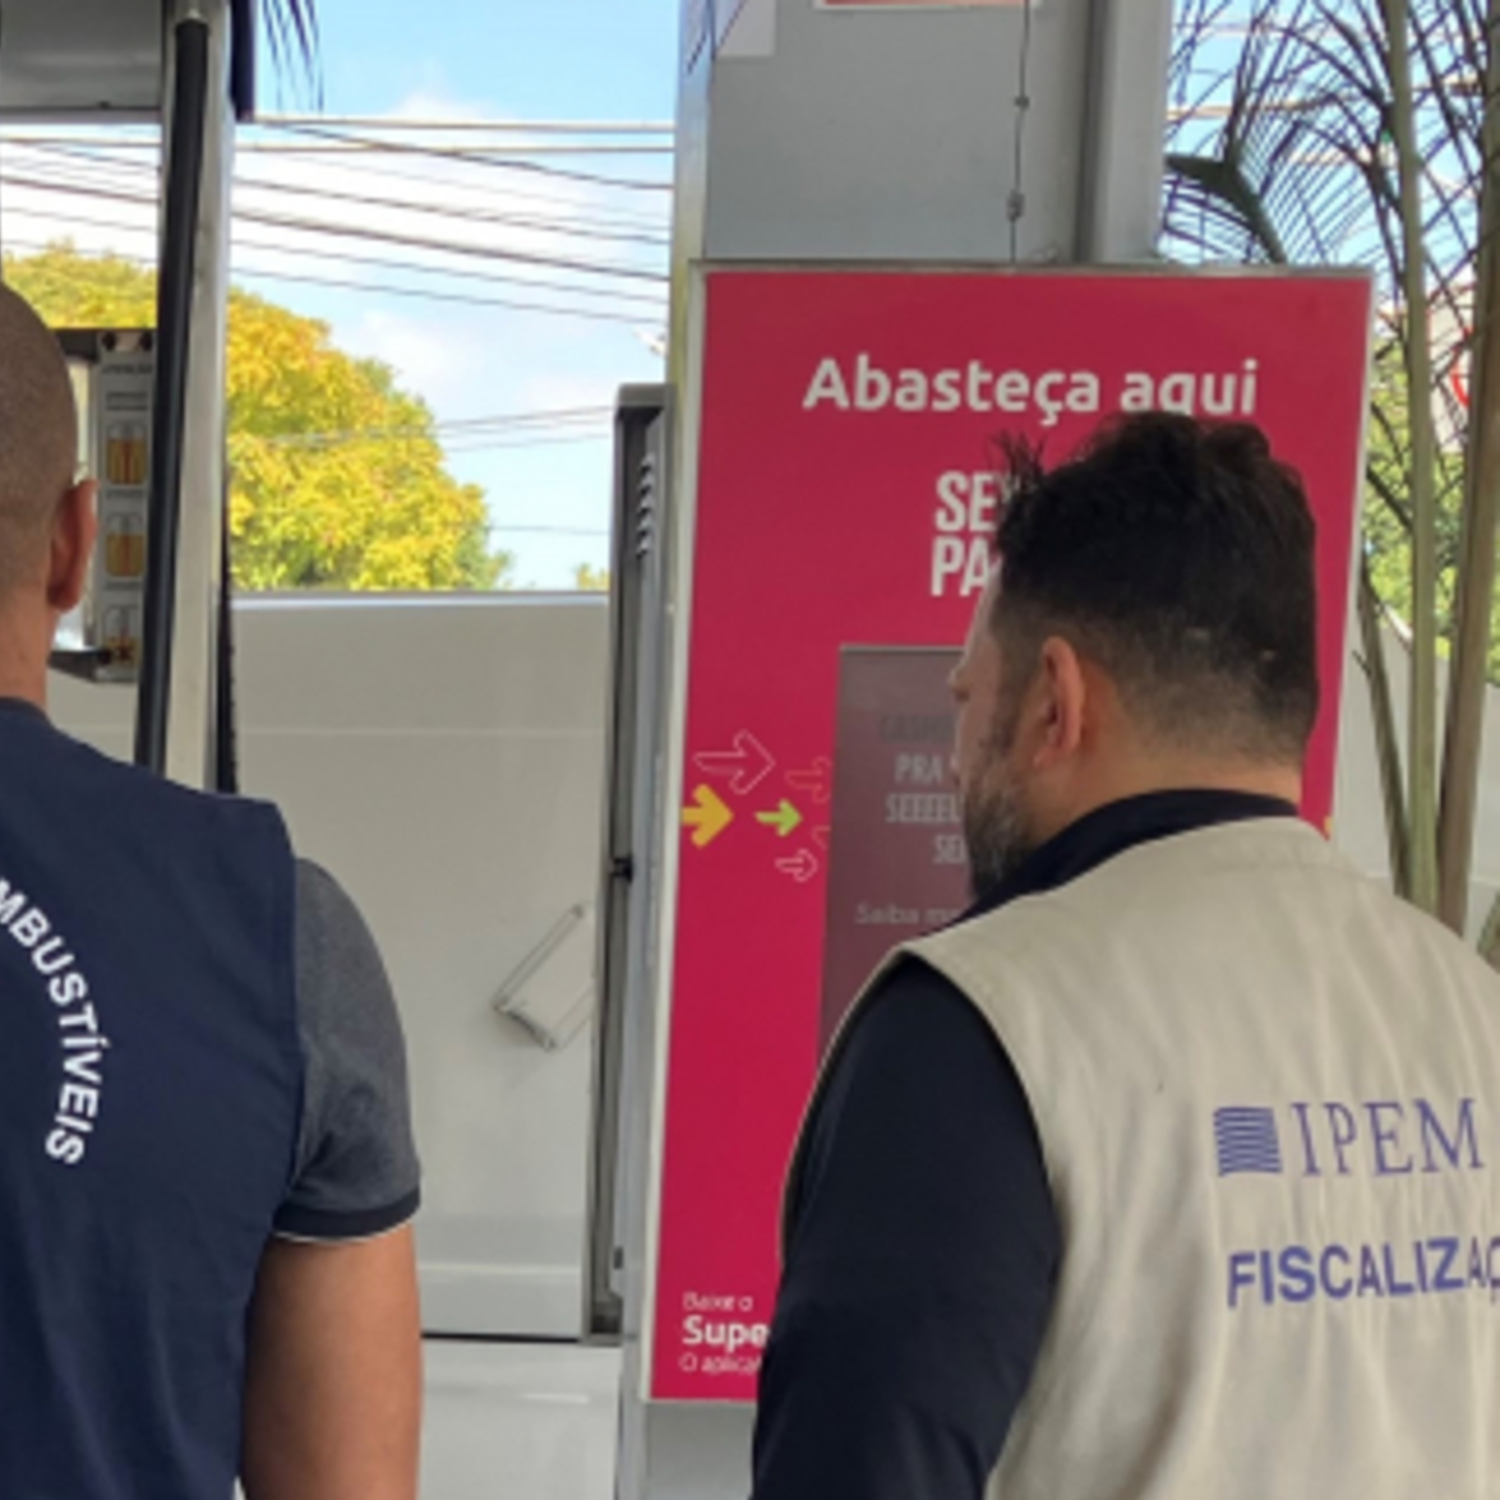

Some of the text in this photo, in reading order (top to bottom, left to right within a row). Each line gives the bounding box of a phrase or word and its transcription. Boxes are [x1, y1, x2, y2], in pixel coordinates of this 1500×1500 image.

[803, 352, 1259, 426] Abasteça aqui
[1290, 1097, 1485, 1178] IPEM
